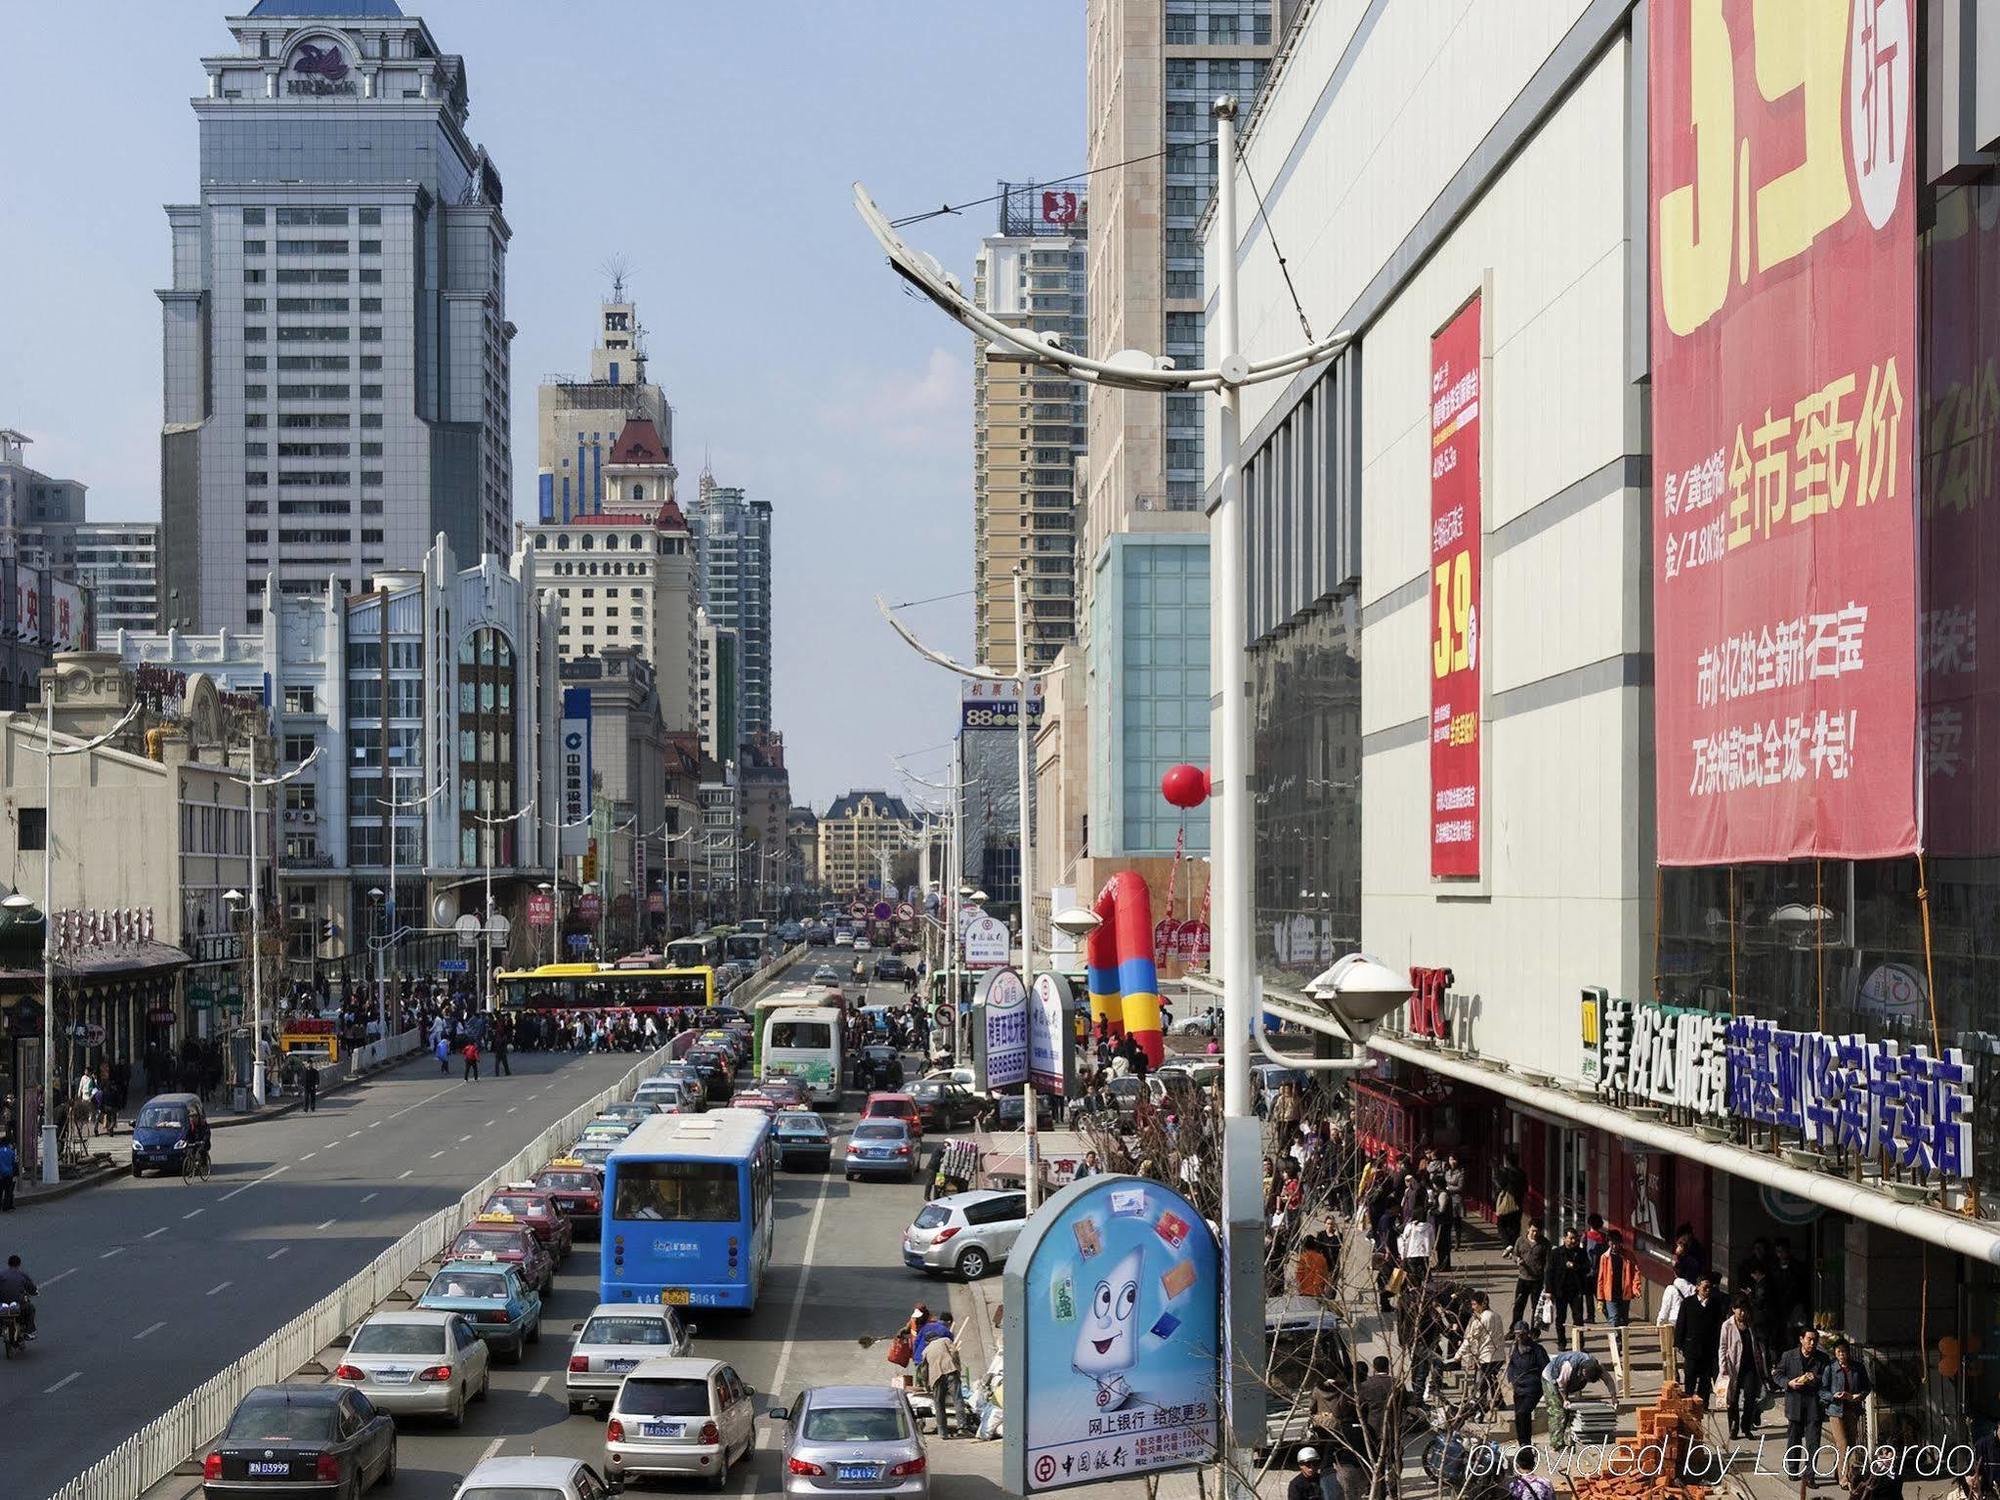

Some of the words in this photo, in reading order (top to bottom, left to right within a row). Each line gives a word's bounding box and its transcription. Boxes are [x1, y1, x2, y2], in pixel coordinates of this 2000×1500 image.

[1088, 1411, 1145, 1437] 网上银行
[1062, 1446, 1129, 1478] 中国银行
